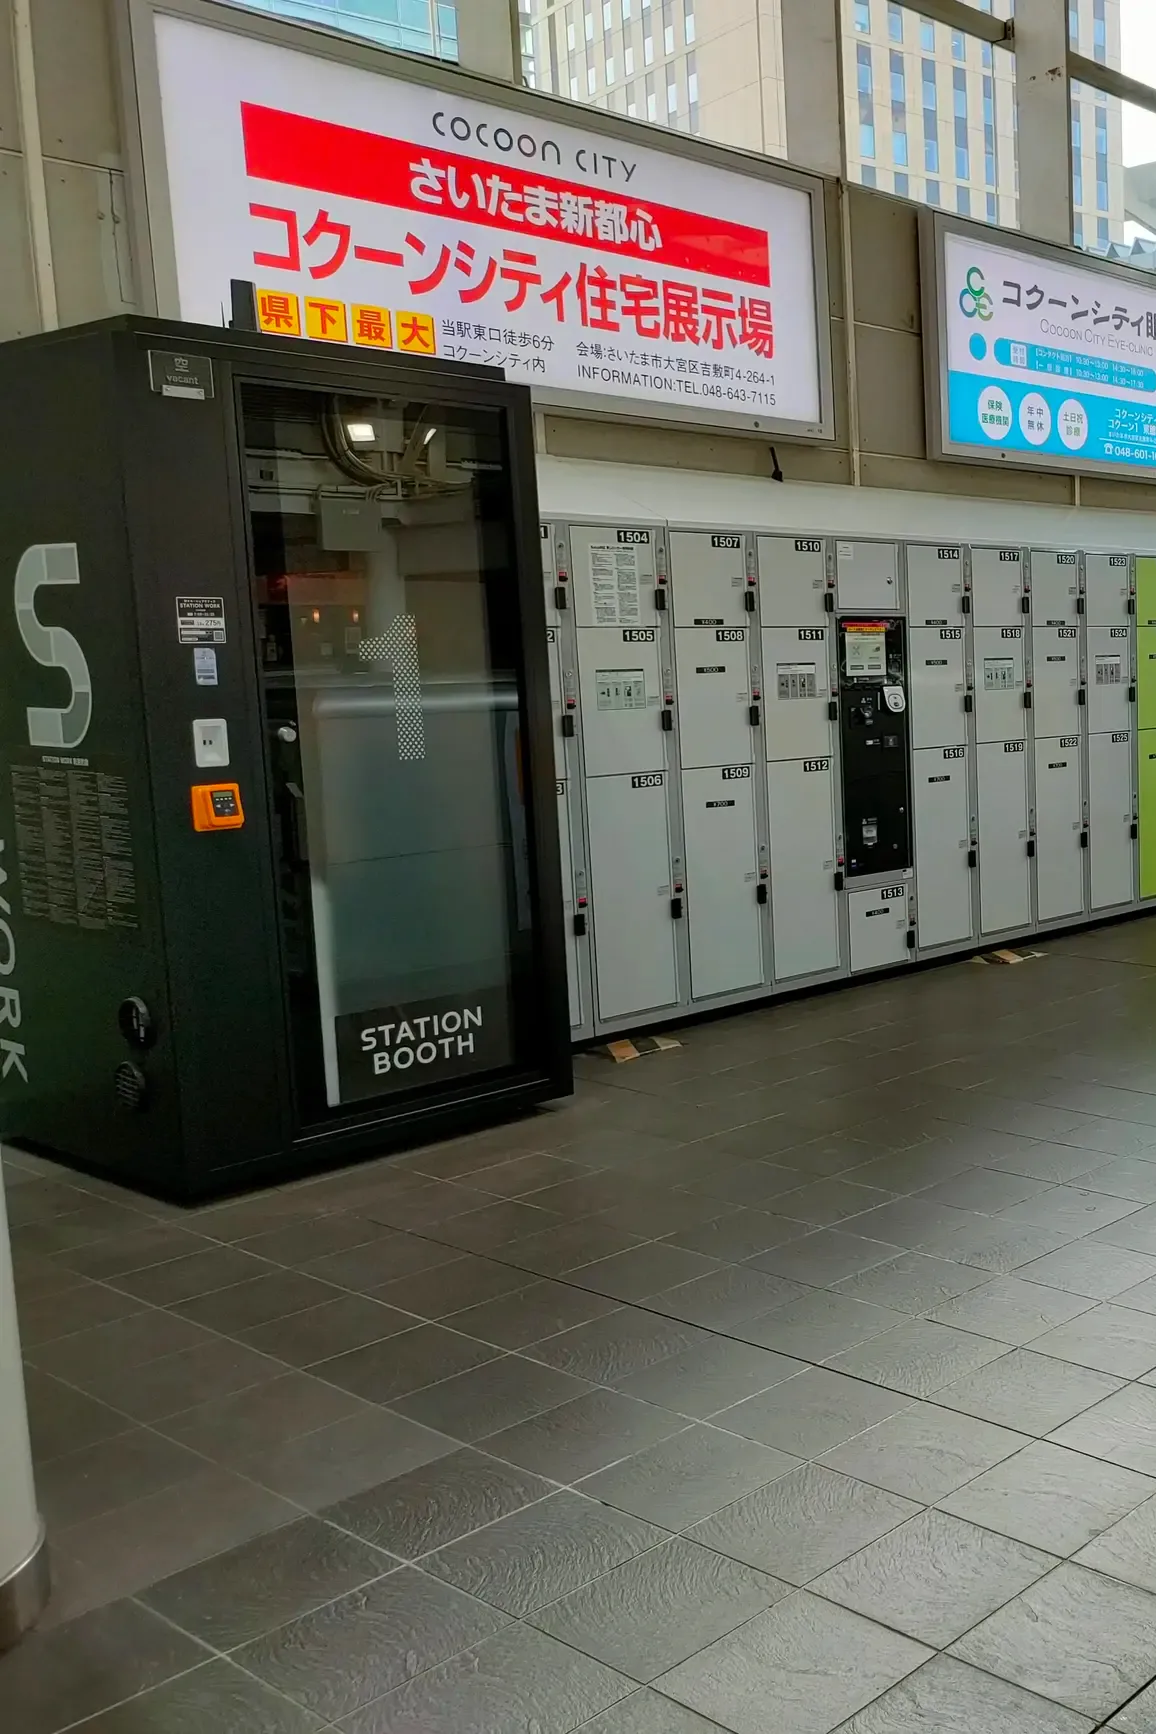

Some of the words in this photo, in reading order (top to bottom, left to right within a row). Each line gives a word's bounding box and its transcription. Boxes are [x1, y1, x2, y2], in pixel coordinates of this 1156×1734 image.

[575, 148, 637, 183] CITY
[409, 157, 662, 252] さいたま新都心
[248, 202, 775, 360] コクーンシティ住宅展示場
[261, 292, 431, 351] 県下最大
[441, 320, 555, 353] 当駅東口徒歩6分
[1084, 328, 1107, 345] CITY
[443, 344, 546, 374] コクーンシティ内
[167, 375, 199, 384] vacant
[1027, 406, 1044, 418] 年中
[1063, 411, 1084, 424] 土日祝
[619, 531, 648, 543] 1504
[713, 537, 740, 548] 1507
[796, 541, 820, 551] 1510
[939, 549, 959, 559] 1514
[1001, 552, 1019, 561] 1517
[1058, 555, 1075, 564] 1520
[1110, 557, 1126, 566] 1523
[624, 631, 654, 641] 1505
[717, 631, 744, 640] 1508
[800, 630, 823, 640] 1511
[941, 629, 961, 639] 1515
[1002, 629, 1021, 638] 1518
[1059, 629, 1076, 638] 1521
[1111, 629, 1127, 637] 1524
[1061, 738, 1078, 747] 1522
[1113, 733, 1128, 742] 1525
[1005, 742, 1023, 751] 1519
[945, 748, 964, 758] 1516
[805, 761, 828, 771] 1512
[723, 767, 750, 779] 1509
[633, 775, 662, 787] 1506
[882, 887, 904, 898] 1513
[361, 1006, 483, 1051] STATION
[374, 1033, 475, 1075] BOOTH
